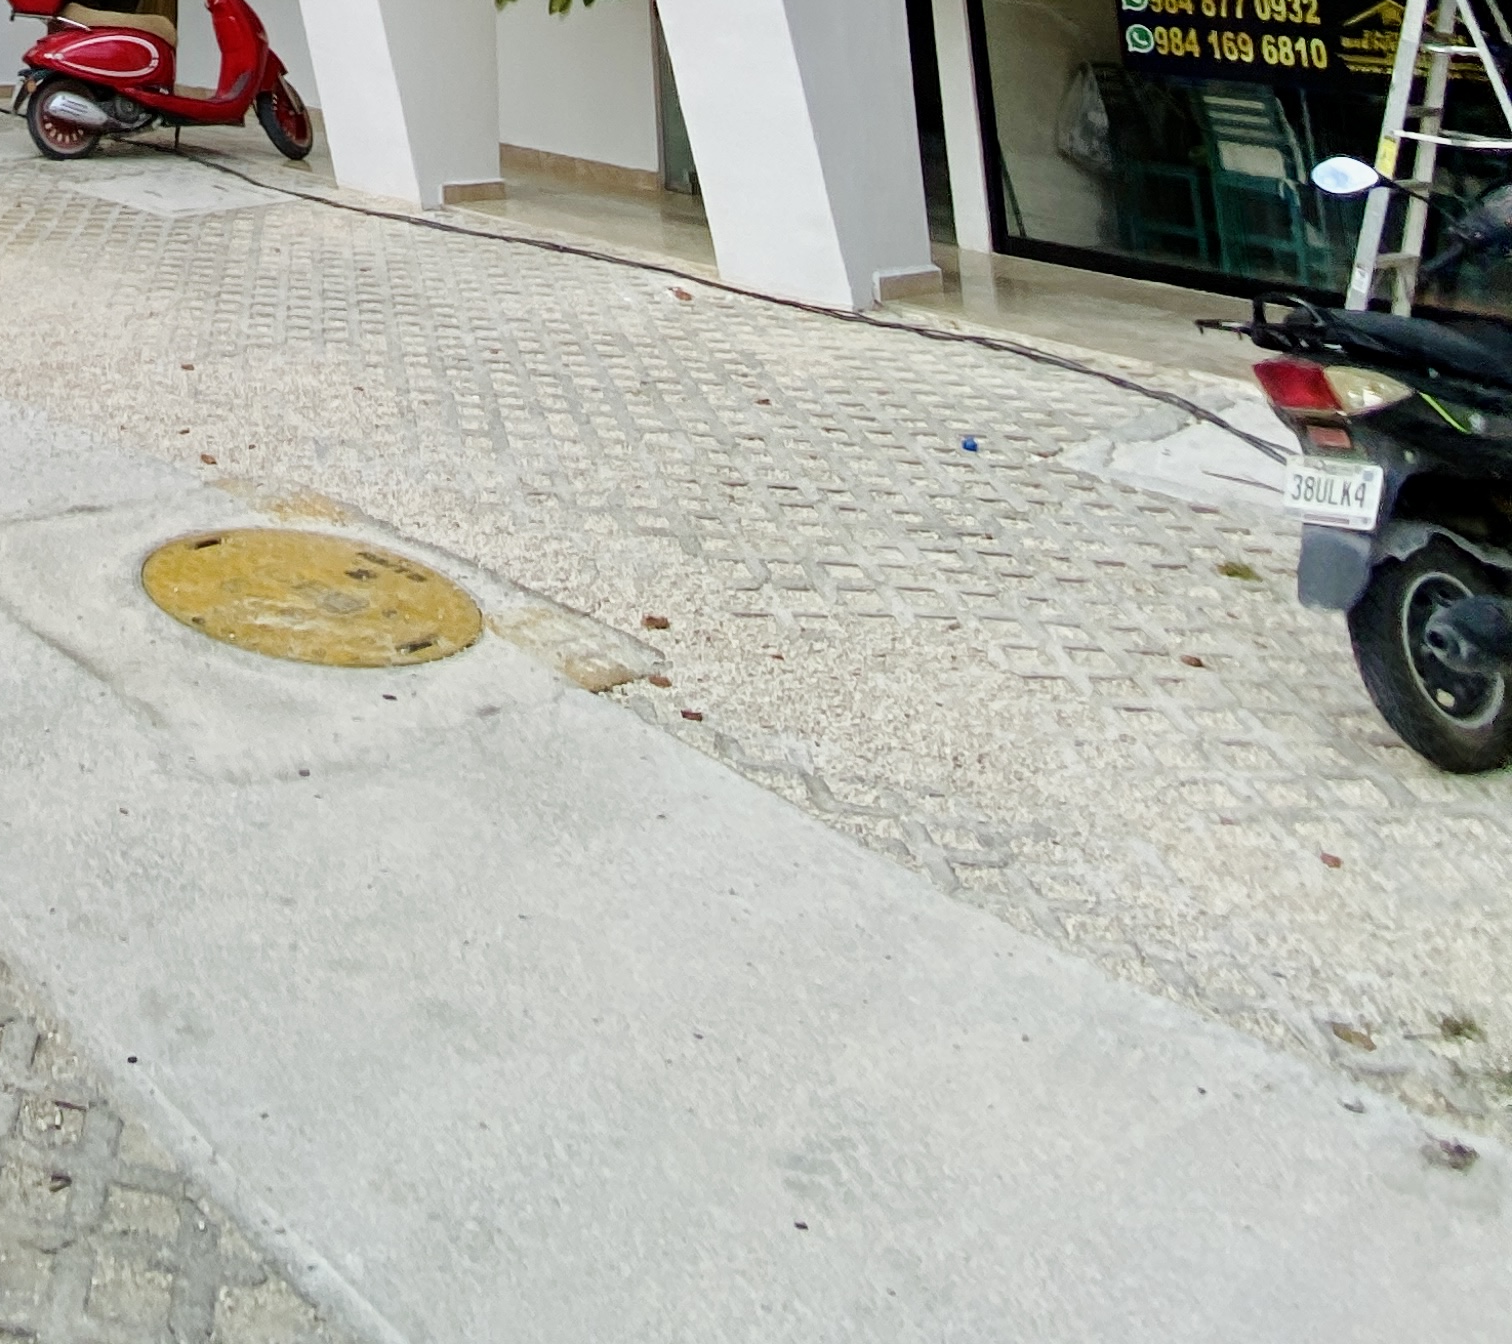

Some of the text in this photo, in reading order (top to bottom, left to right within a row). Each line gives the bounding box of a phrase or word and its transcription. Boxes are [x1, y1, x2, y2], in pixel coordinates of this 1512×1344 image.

[1155, 26, 1201, 58] 984
[1207, 30, 1255, 63] 169
[1262, 33, 1328, 69] 6810
[1291, 473, 1367, 509] 38ULK4
